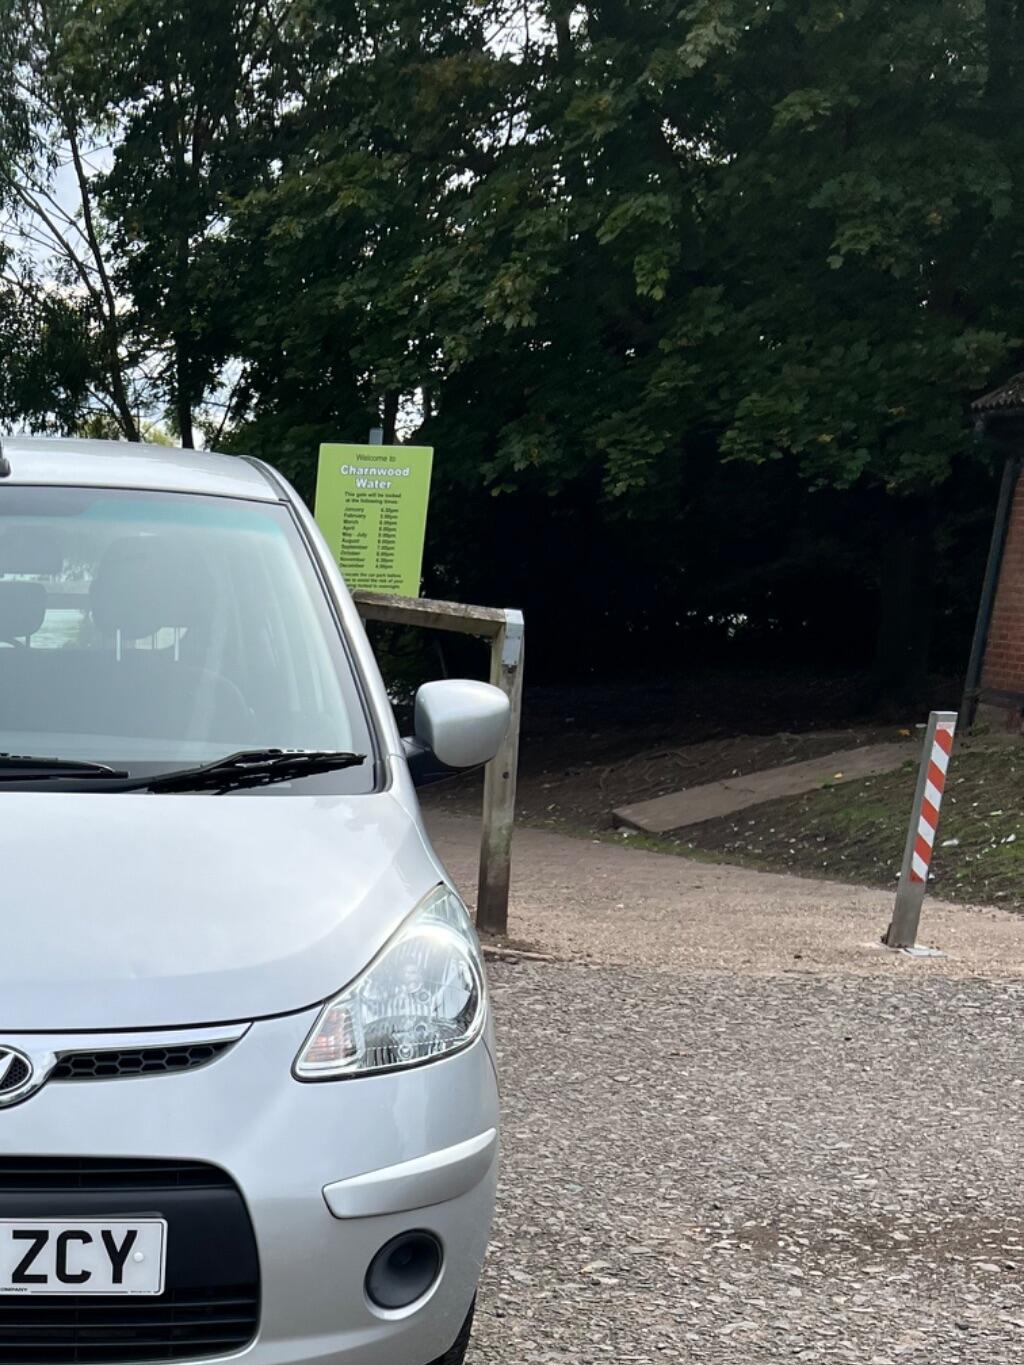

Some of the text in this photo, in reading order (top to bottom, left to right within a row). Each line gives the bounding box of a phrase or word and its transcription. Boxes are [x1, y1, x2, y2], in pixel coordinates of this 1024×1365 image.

[356, 454, 387, 462] Welcome
[341, 464, 410, 477] Charnwood
[356, 477, 392, 489] Water
[12, 1229, 138, 1284] ZCY
